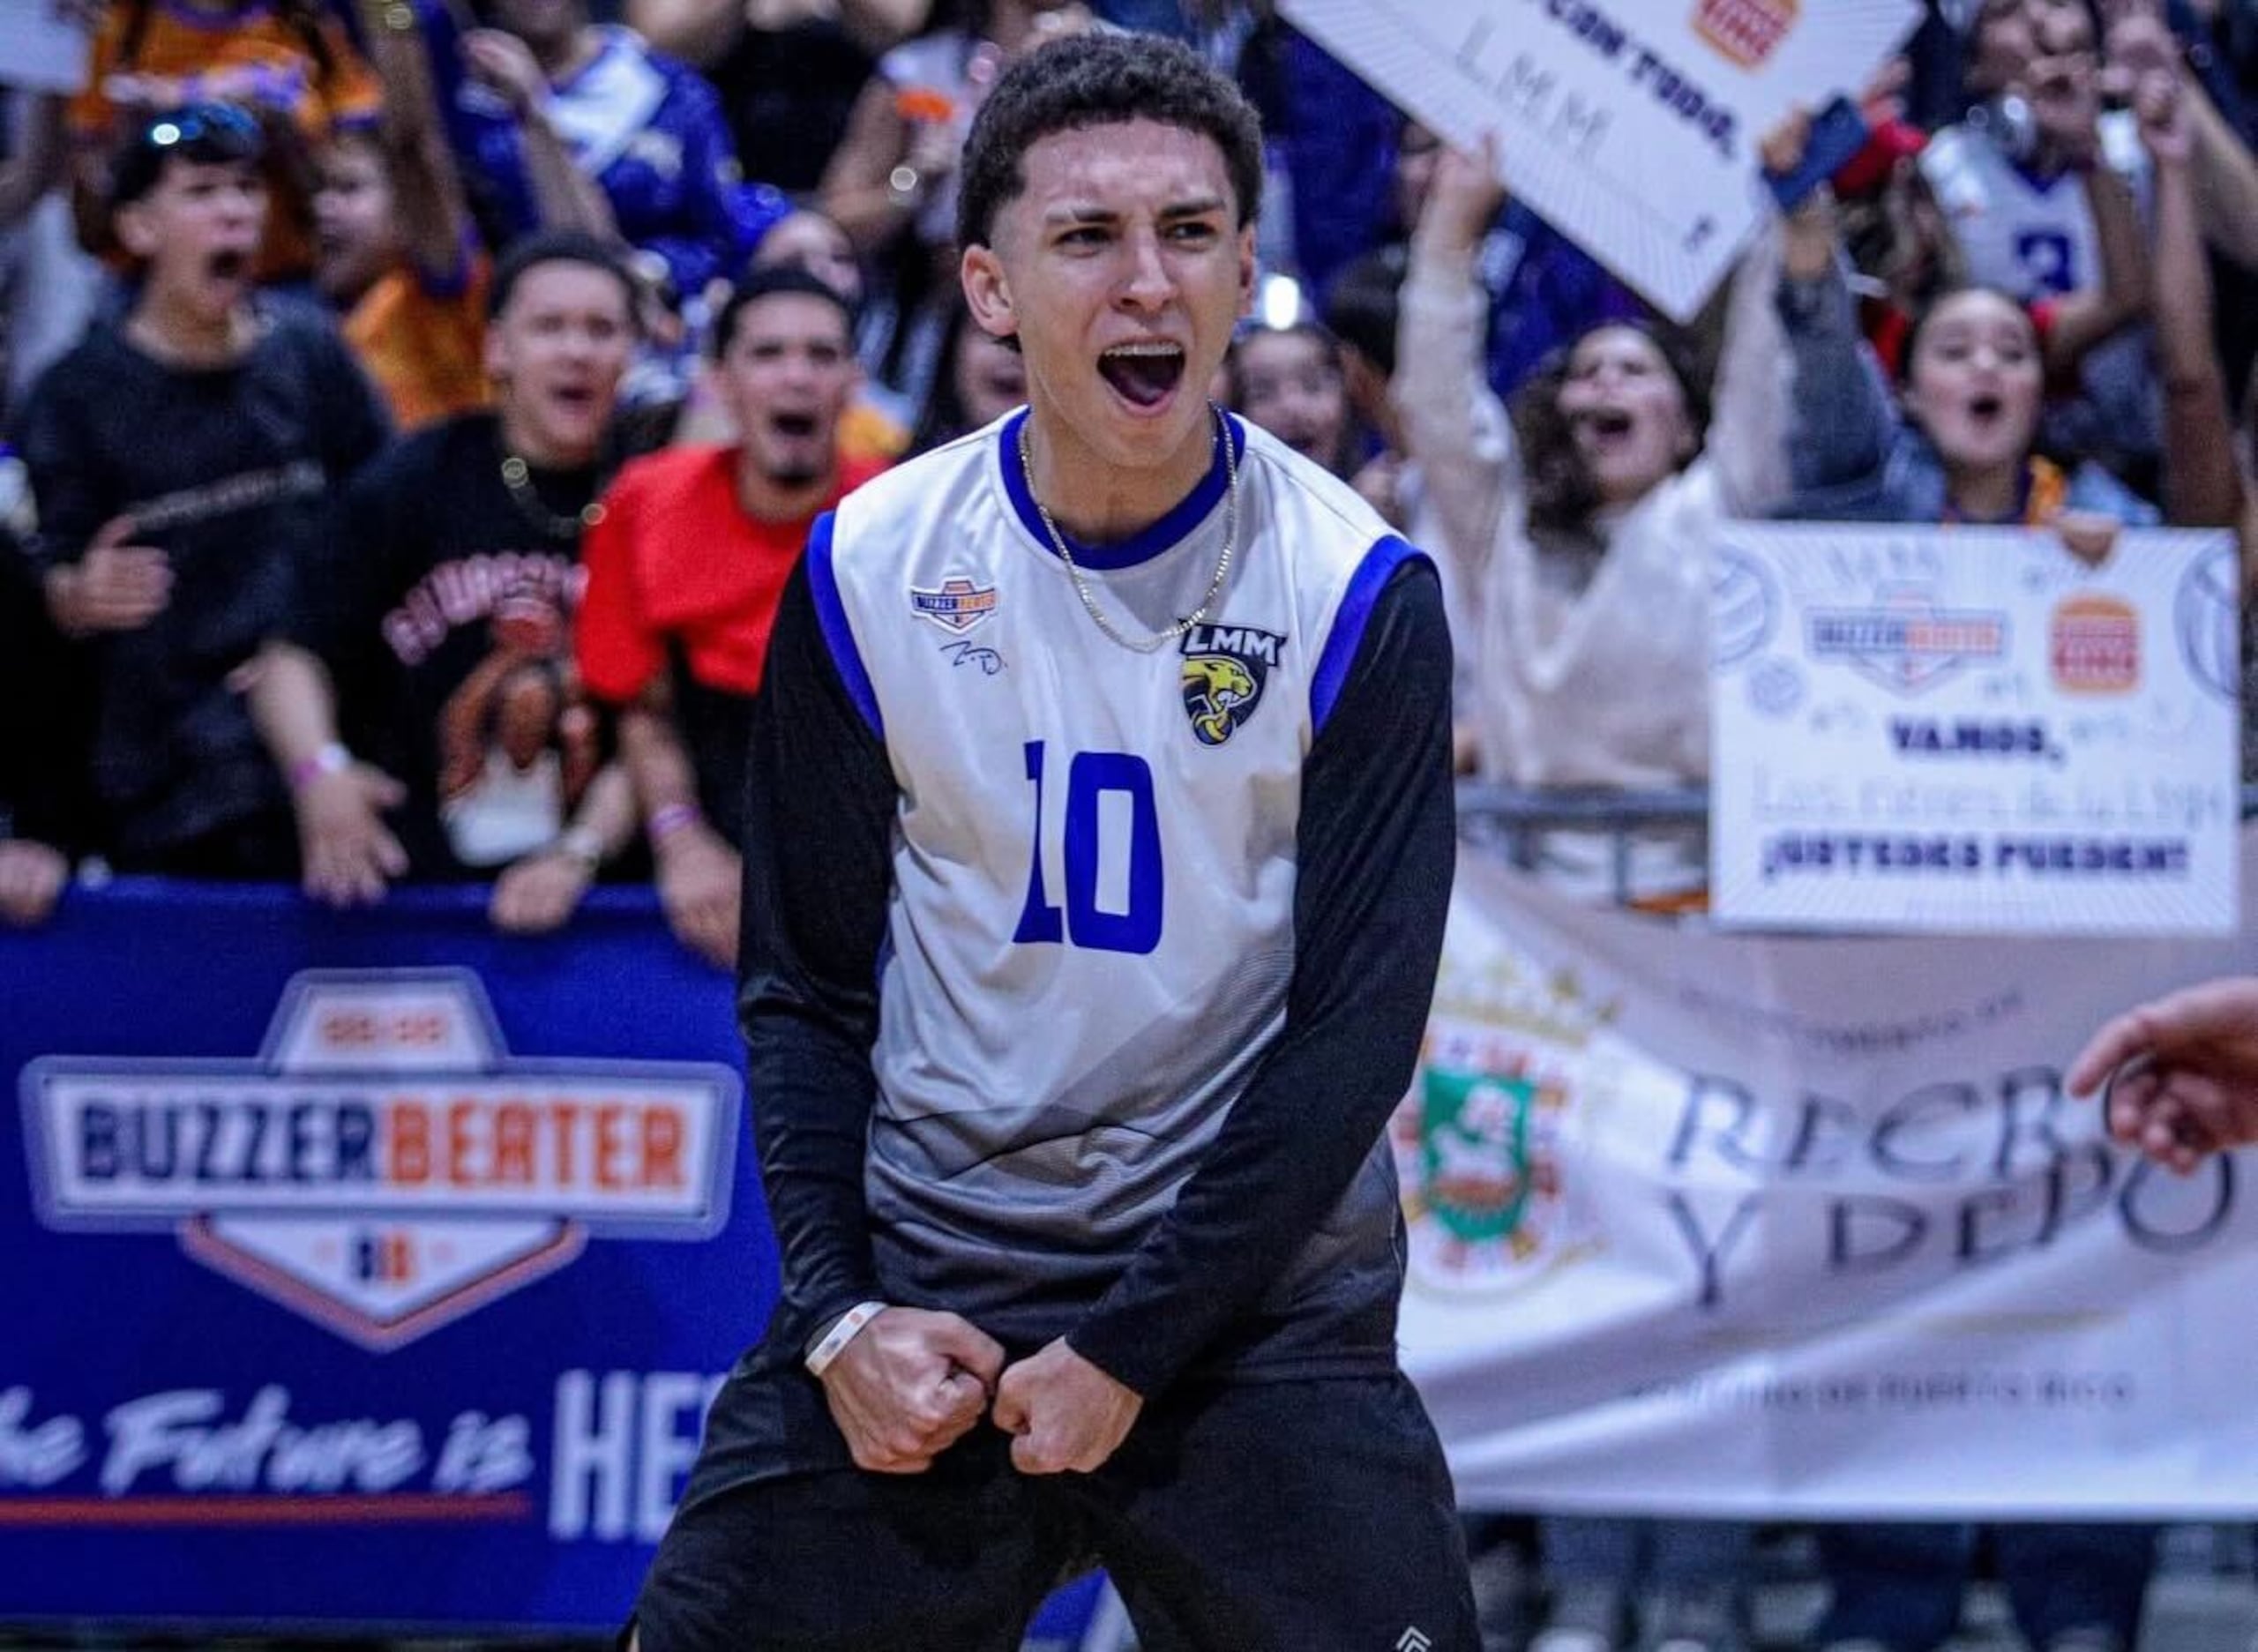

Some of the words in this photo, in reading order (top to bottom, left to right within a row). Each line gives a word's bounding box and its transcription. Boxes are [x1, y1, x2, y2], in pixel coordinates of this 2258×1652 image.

[1184, 625, 1276, 665] LMM
[1013, 740, 1163, 955] 10
[79, 1100, 686, 1189] BUZZERBEATER
[1669, 1191, 1763, 1307] Y
[101, 1386, 425, 1494] Future
[434, 1411, 533, 1492] is
[550, 1371, 729, 1540] HE
